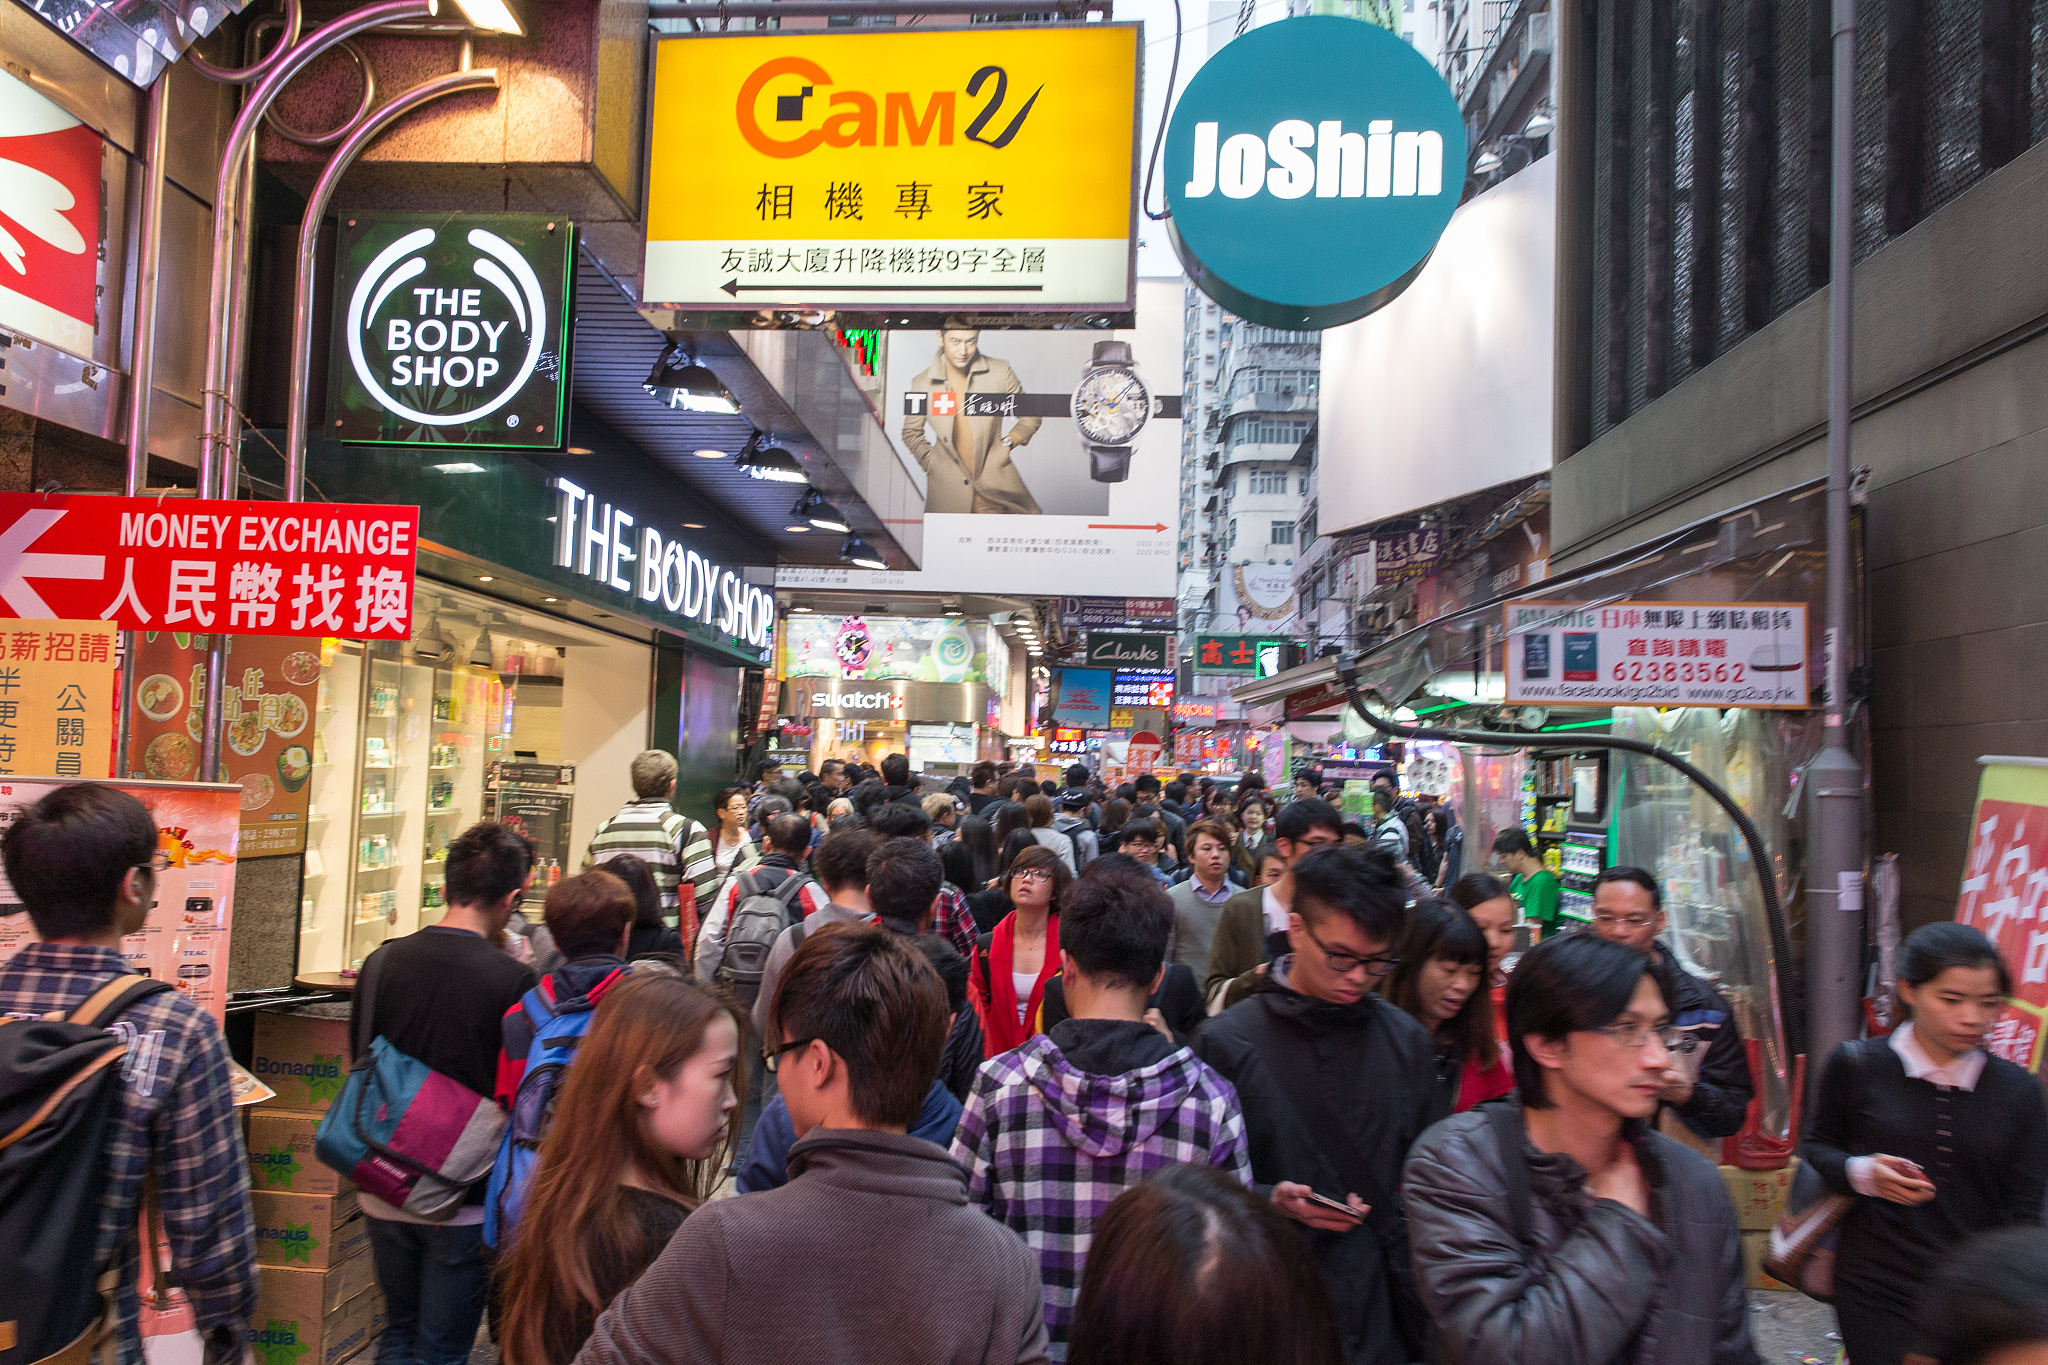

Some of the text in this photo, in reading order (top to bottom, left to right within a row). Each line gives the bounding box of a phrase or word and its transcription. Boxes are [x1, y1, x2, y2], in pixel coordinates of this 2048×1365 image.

[1185, 119, 1444, 200] JoShin
[755, 181, 1005, 221] 相機專家
[720, 246, 1046, 275] 友誠大廈升降機按9字全層
[413, 288, 481, 317] THE
[387, 321, 509, 353] BODY
[391, 354, 500, 388] SHOP
[119, 512, 411, 556] MONEY EXCHANGE
[553, 477, 774, 648] THE BODY SHOP
[101, 557, 409, 634] 人民幣找換
[0, 631, 111, 663] 薪招請
[1091, 640, 1160, 661] Clarks
[1612, 661, 1747, 684] 62383562
[811, 690, 892, 710] swatch
[255, 1057, 339, 1079] Bonaqua
